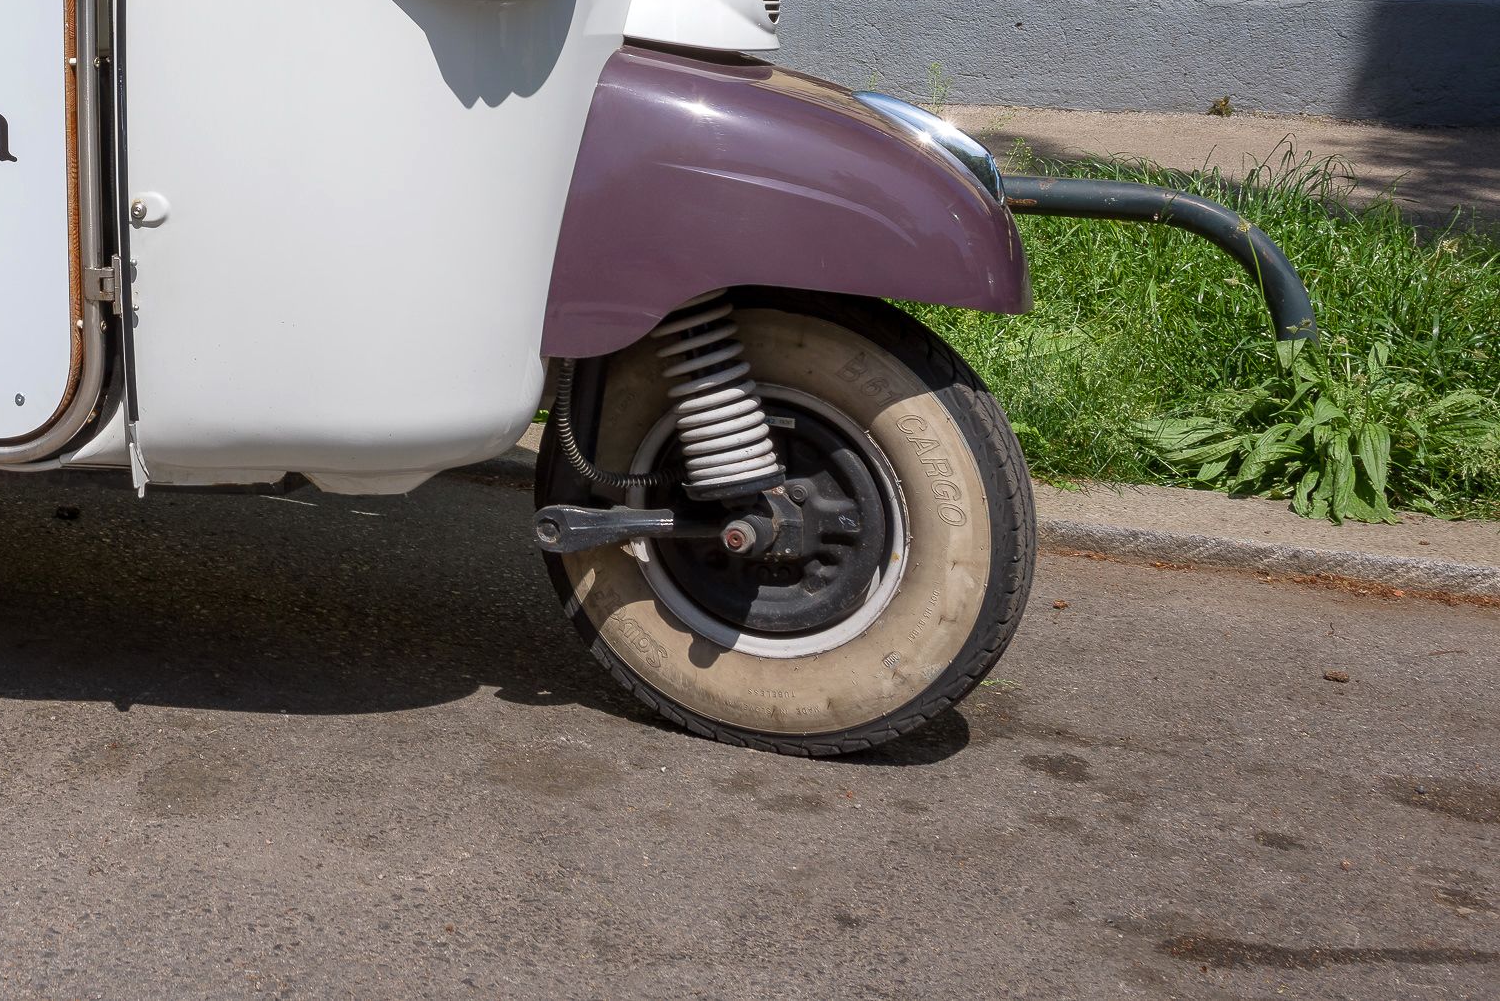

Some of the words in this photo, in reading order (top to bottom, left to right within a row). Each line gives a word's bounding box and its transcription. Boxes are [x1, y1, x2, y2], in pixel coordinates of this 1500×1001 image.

[895, 414, 968, 527] CARGO
[747, 688, 796, 698] TUBELESS
[795, 705, 821, 716] MADE
